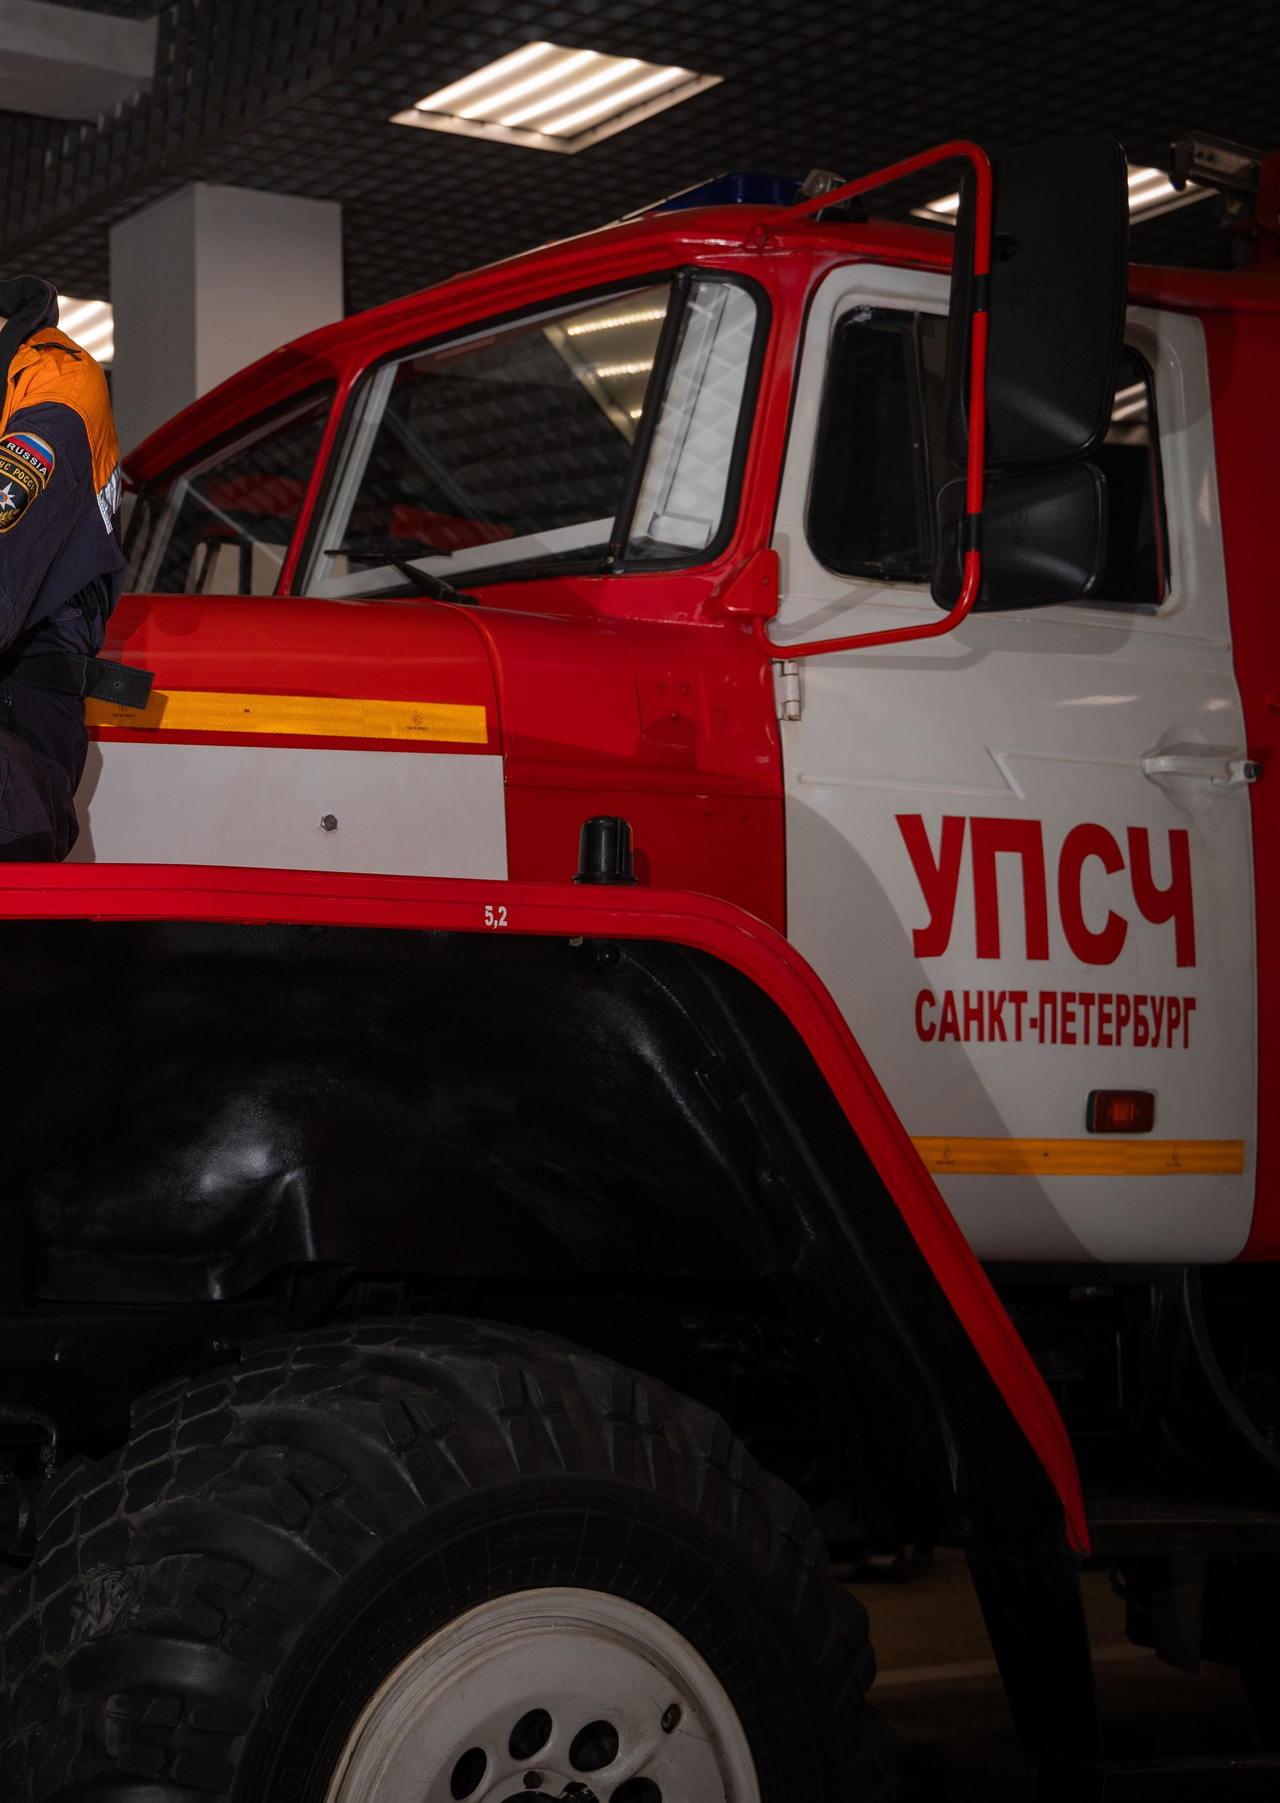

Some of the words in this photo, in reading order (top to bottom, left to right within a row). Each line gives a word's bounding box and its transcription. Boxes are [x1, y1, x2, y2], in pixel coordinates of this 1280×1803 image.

[6, 441, 48, 477] RUSSIA
[894, 814, 1196, 968] УПСЧ
[484, 905, 508, 930] 5,2
[914, 988, 1197, 1050] САНКТ-ПЕТЕРБУРГ
